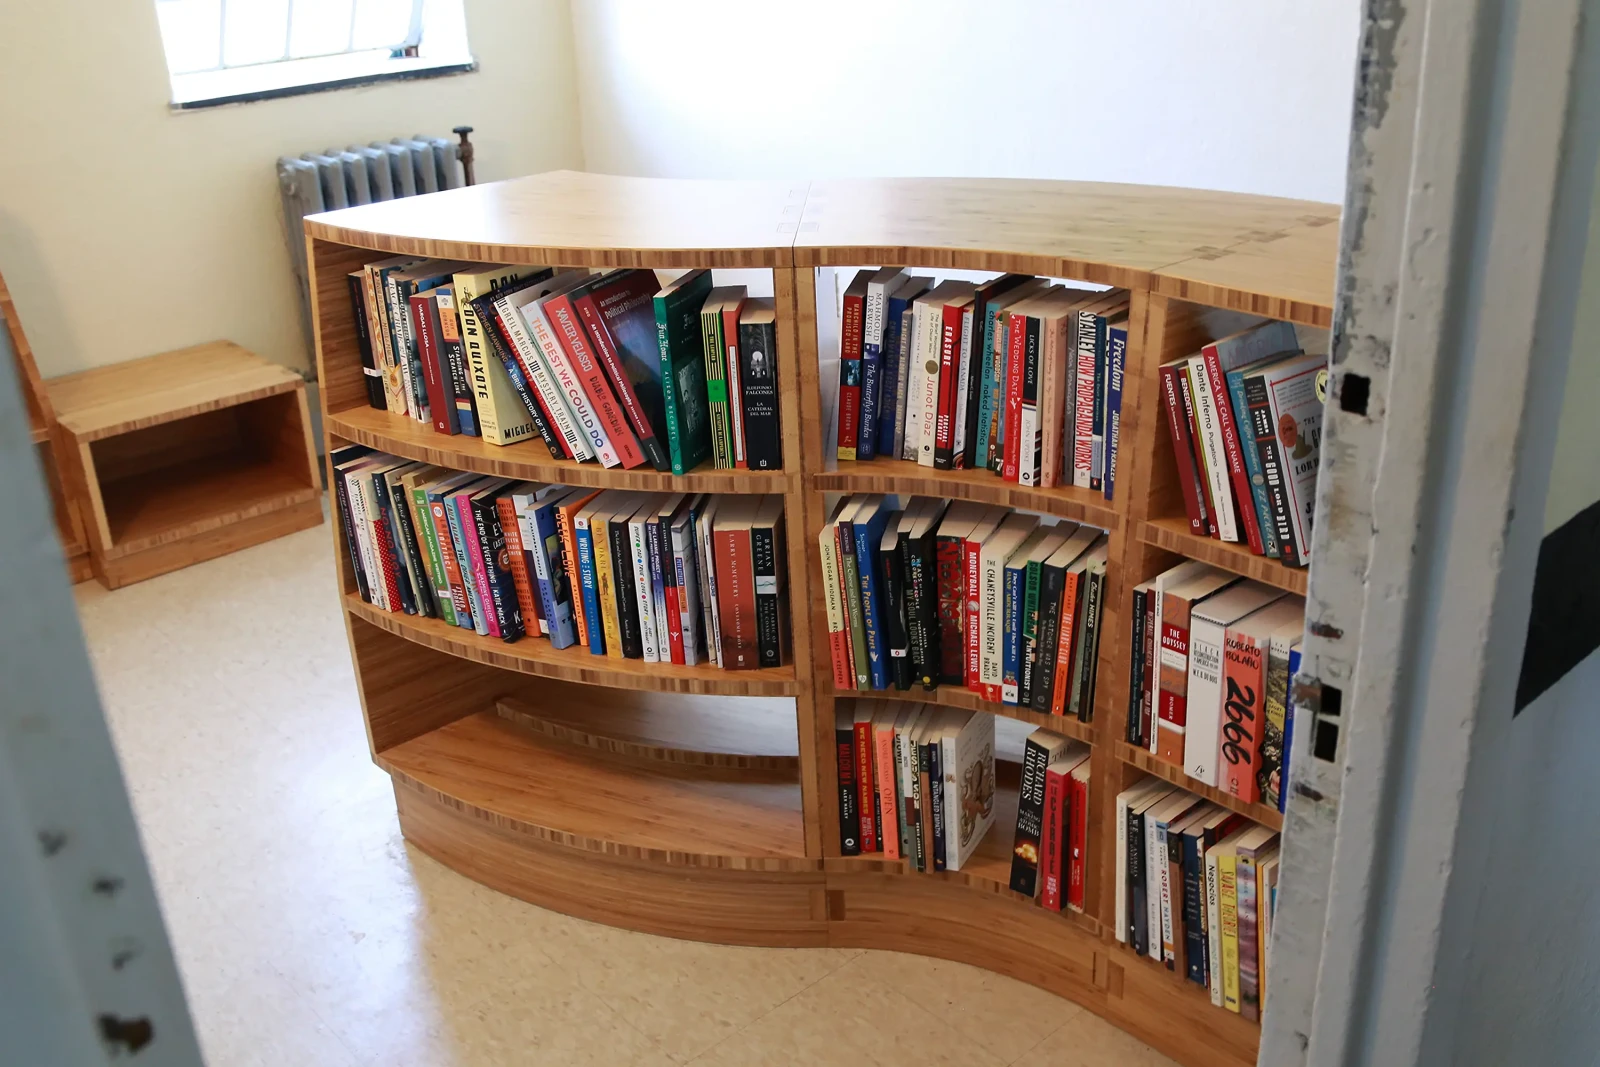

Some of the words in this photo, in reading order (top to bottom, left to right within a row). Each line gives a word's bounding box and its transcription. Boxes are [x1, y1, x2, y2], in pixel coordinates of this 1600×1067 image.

[417, 303, 426, 328] VARGAS
[463, 308, 478, 336] DON
[590, 322, 597, 330] An
[866, 295, 874, 338] DARWISH
[871, 292, 883, 341] MAHMOUD
[986, 310, 995, 341] charles
[421, 328, 429, 347] LLOSA
[473, 303, 493, 334] STEPHEN
[489, 332, 508, 362] HAWKING
[500, 307, 517, 329] GREIL
[512, 329, 534, 361] MARCUS
[555, 307, 577, 339] XAVIER
[569, 336, 593, 372] VELASCO
[656, 321, 668, 339] Fun
[1078, 311, 1096, 353] STANLEY
[593, 329, 610, 358] Introduction
[658, 338, 670, 361] Home
[942, 325, 952, 365] ERASURE
[961, 347, 967, 357] TO
[1012, 335, 1021, 373] WEDDING
[468, 340, 489, 400] QUIXOTE
[609, 362, 621, 381] Political
[866, 363, 875, 376] The
[984, 343, 993, 379] wheelan
[1028, 354, 1034, 364] OF
[1077, 354, 1095, 375] HOW
[1107, 337, 1127, 391] Freedom
[510, 372, 524, 392] BRIEF
[529, 316, 549, 341] THE
[542, 340, 563, 369] BEST
[557, 368, 573, 388] WE
[566, 387, 595, 429] COULD
[589, 428, 604, 448] DO
[1011, 375, 1019, 395] DATE
[1207, 355, 1221, 392] AMERICA,
[536, 371, 559, 406] MYSTERY
[555, 407, 571, 429] TRAIN
[617, 380, 633, 406] Philosophy
[862, 378, 874, 412] Butterfly's
[924, 376, 935, 408] Junot
[981, 383, 990, 410] naked
[1164, 373, 1176, 405] FUENTES
[1180, 376, 1192, 416] BENEDETTI
[1216, 392, 1225, 406] WE
[520, 391, 538, 419] HISTORY
[1075, 377, 1094, 436] PROPAGANDA
[1195, 364, 1206, 392] Dante
[1201, 395, 1212, 429] Inferno
[1207, 431, 1218, 466] Purgatorio
[1219, 406, 1229, 426] CALL
[1236, 389, 1247, 419] Drinking
[503, 422, 536, 439] MIGUEL
[534, 417, 543, 427] OF
[538, 426, 551, 443] TIME
[862, 413, 872, 438] Burden
[923, 411, 933, 436] Díaz
[941, 414, 949, 442] PERCIVAL
[979, 412, 988, 445] statistics
[1243, 419, 1252, 439] Coffee
[1224, 426, 1234, 449] YOUR
[1074, 439, 1092, 470] WORKS
[1229, 450, 1240, 473] NAME
[1247, 439, 1258, 471] Elsewhere
[1265, 445, 1273, 459] THE
[1265, 461, 1280, 486] GOOD
[1257, 487, 1266, 503] ZZ
[1273, 487, 1283, 513] LORD
[474, 509, 482, 521] THE
[1260, 503, 1274, 541] PACKER
[1276, 514, 1290, 540] BIRD
[477, 522, 486, 535] END
[480, 535, 488, 545] OF
[419, 508, 431, 534] AMERICAN
[426, 535, 438, 562] MAGAZINE
[433, 562, 443, 584] WRITING
[438, 531, 451, 570] INSTINCT
[579, 537, 589, 563] WRITING
[728, 533, 736, 556] LARRY
[755, 534, 763, 570] GREENE
[482, 545, 497, 584] EVERYTHING
[825, 562, 833, 580] EDGAR
[968, 551, 977, 596] MONEYBALL
[582, 568, 592, 589] STORY
[730, 559, 739, 597] McMURTRY
[861, 574, 870, 588] THE
[492, 588, 502, 606] KATIE
[828, 583, 836, 610] WIDEMAN
[846, 568, 854, 587] Cheese
[851, 608, 859, 627] Worms
[862, 590, 873, 615] PEOPLE
[905, 589, 913, 600] MY
[986, 568, 995, 621] CHANEYSVILLE
[496, 606, 506, 624] MACK
[866, 618, 873, 627] OF
[907, 601, 915, 619] SOUL
[831, 621, 840, 651] BROTHERS
[867, 629, 876, 649] PAPER
[909, 621, 918, 644] LOOKS
[969, 614, 978, 646] MICHAEL
[986, 622, 995, 654] INCIDENT
[1045, 618, 1054, 648] CATCHER
[1162, 635, 1187, 651] ODYSSEY
[1169, 628, 1180, 639] THE
[911, 646, 920, 664] BACK
[970, 649, 978, 672] LEWIS
[1226, 637, 1260, 658] ROBERTO
[835, 659, 843, 683] KEEPERS
[982, 657, 990, 679] BRADLEY
[990, 662, 998, 677] DAVID
[859, 726, 864, 739] WE
[1222, 676, 1256, 765] 2666
[1021, 746, 1036, 800] RHODES
[1032, 752, 1046, 805] RICHARD
[883, 787, 893, 814] OPEN
[931, 780, 940, 812] ENTANGLED
[1205, 864, 1218, 906] Negocios
[1220, 868, 1235, 898] SAVAGE
[1221, 902, 1237, 938] THEORIES
